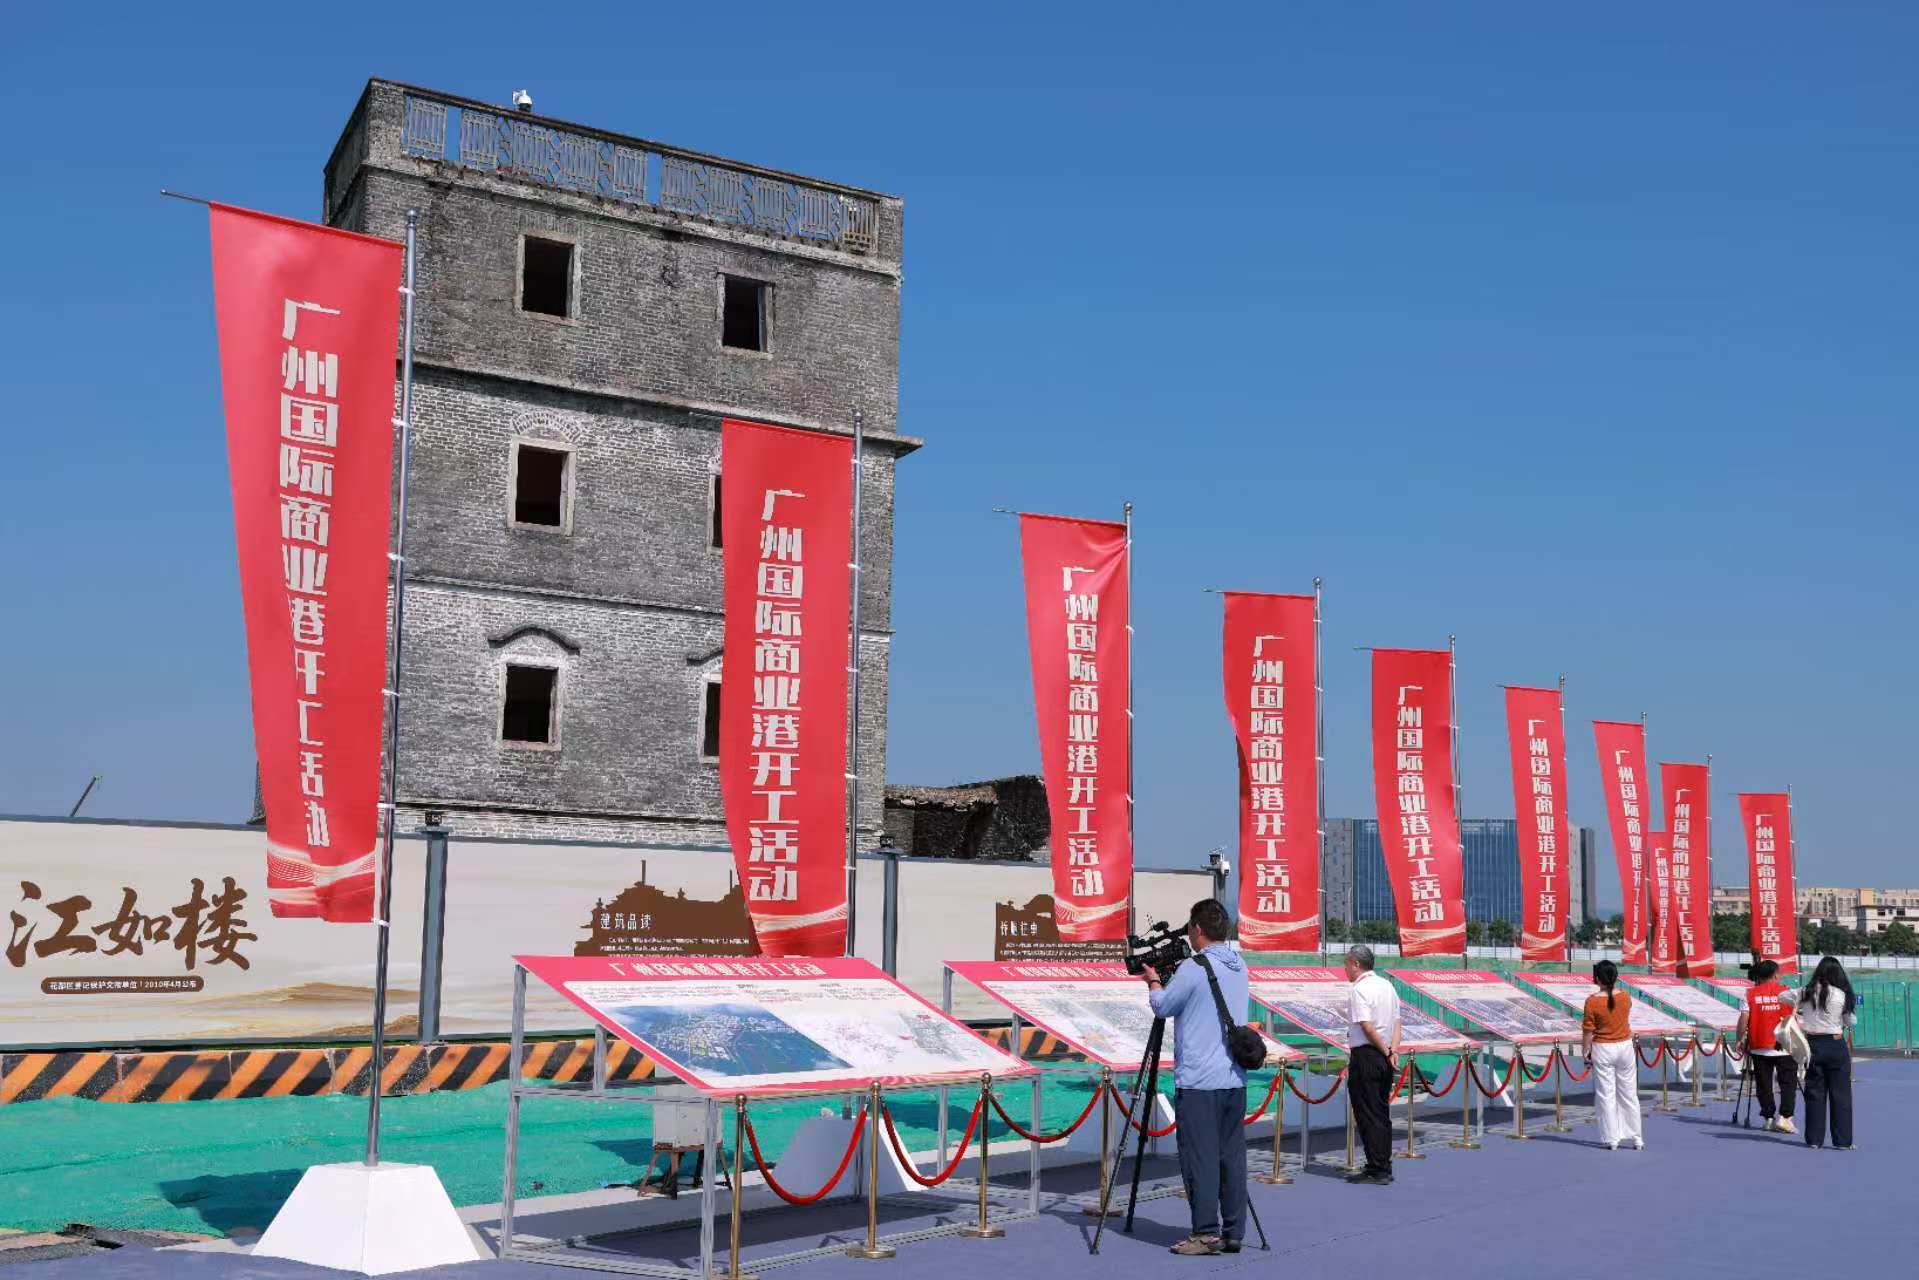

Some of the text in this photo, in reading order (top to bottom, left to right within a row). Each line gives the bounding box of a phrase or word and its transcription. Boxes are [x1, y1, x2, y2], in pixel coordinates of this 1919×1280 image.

[747, 488, 806, 902] 广州国际商业港开工活动
[1062, 566, 1104, 897] 广州国际商业港开工活动
[1249, 634, 1291, 913] 广州国际商业港开工活动
[1397, 685, 1444, 922] 广州国际商业港开工活动
[1528, 719, 1556, 933] 广州国际商业港开工活动
[1756, 814, 1781, 955] 广州国际商业港开工活动
[6, 876, 258, 970] 江如楼
[600, 912, 652, 931] 建筑品读
[608, 963, 827, 976] 广州国际商业港开工活动
